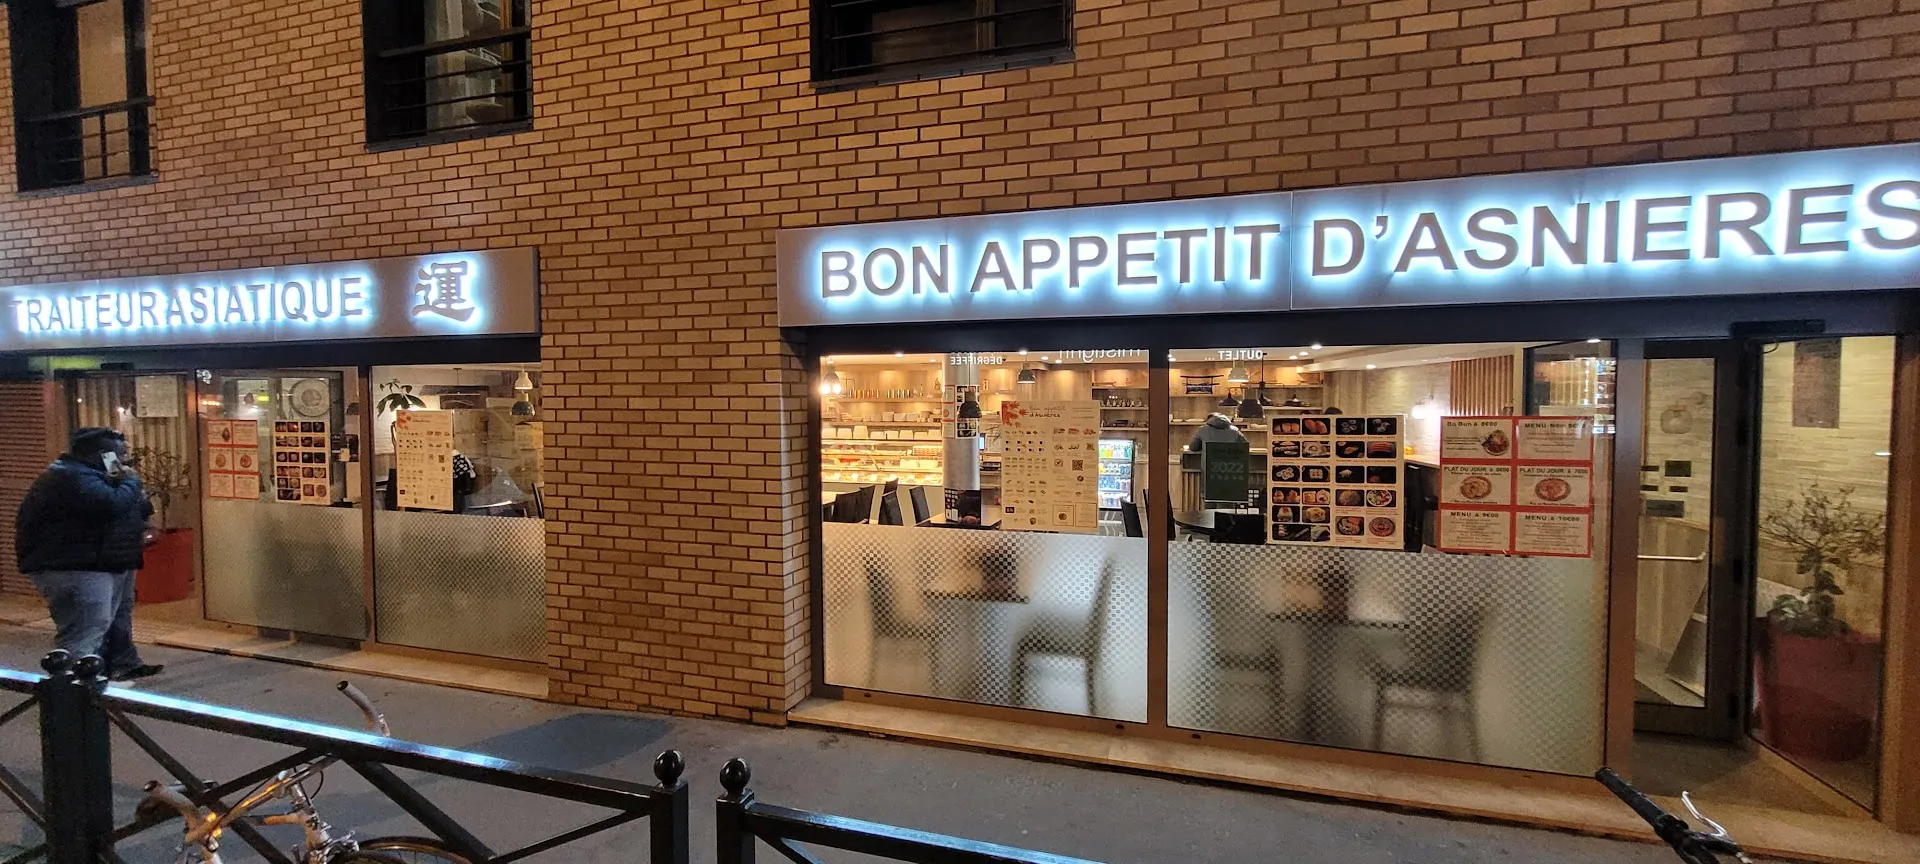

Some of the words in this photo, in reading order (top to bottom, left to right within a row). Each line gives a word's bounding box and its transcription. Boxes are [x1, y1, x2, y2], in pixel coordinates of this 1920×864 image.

[411, 260, 476, 322] 運
[821, 243, 950, 299] BON
[970, 223, 1281, 292] APPETIT
[9, 290, 159, 332] TRAITEUR
[167, 276, 364, 325] ASIATIQUE
